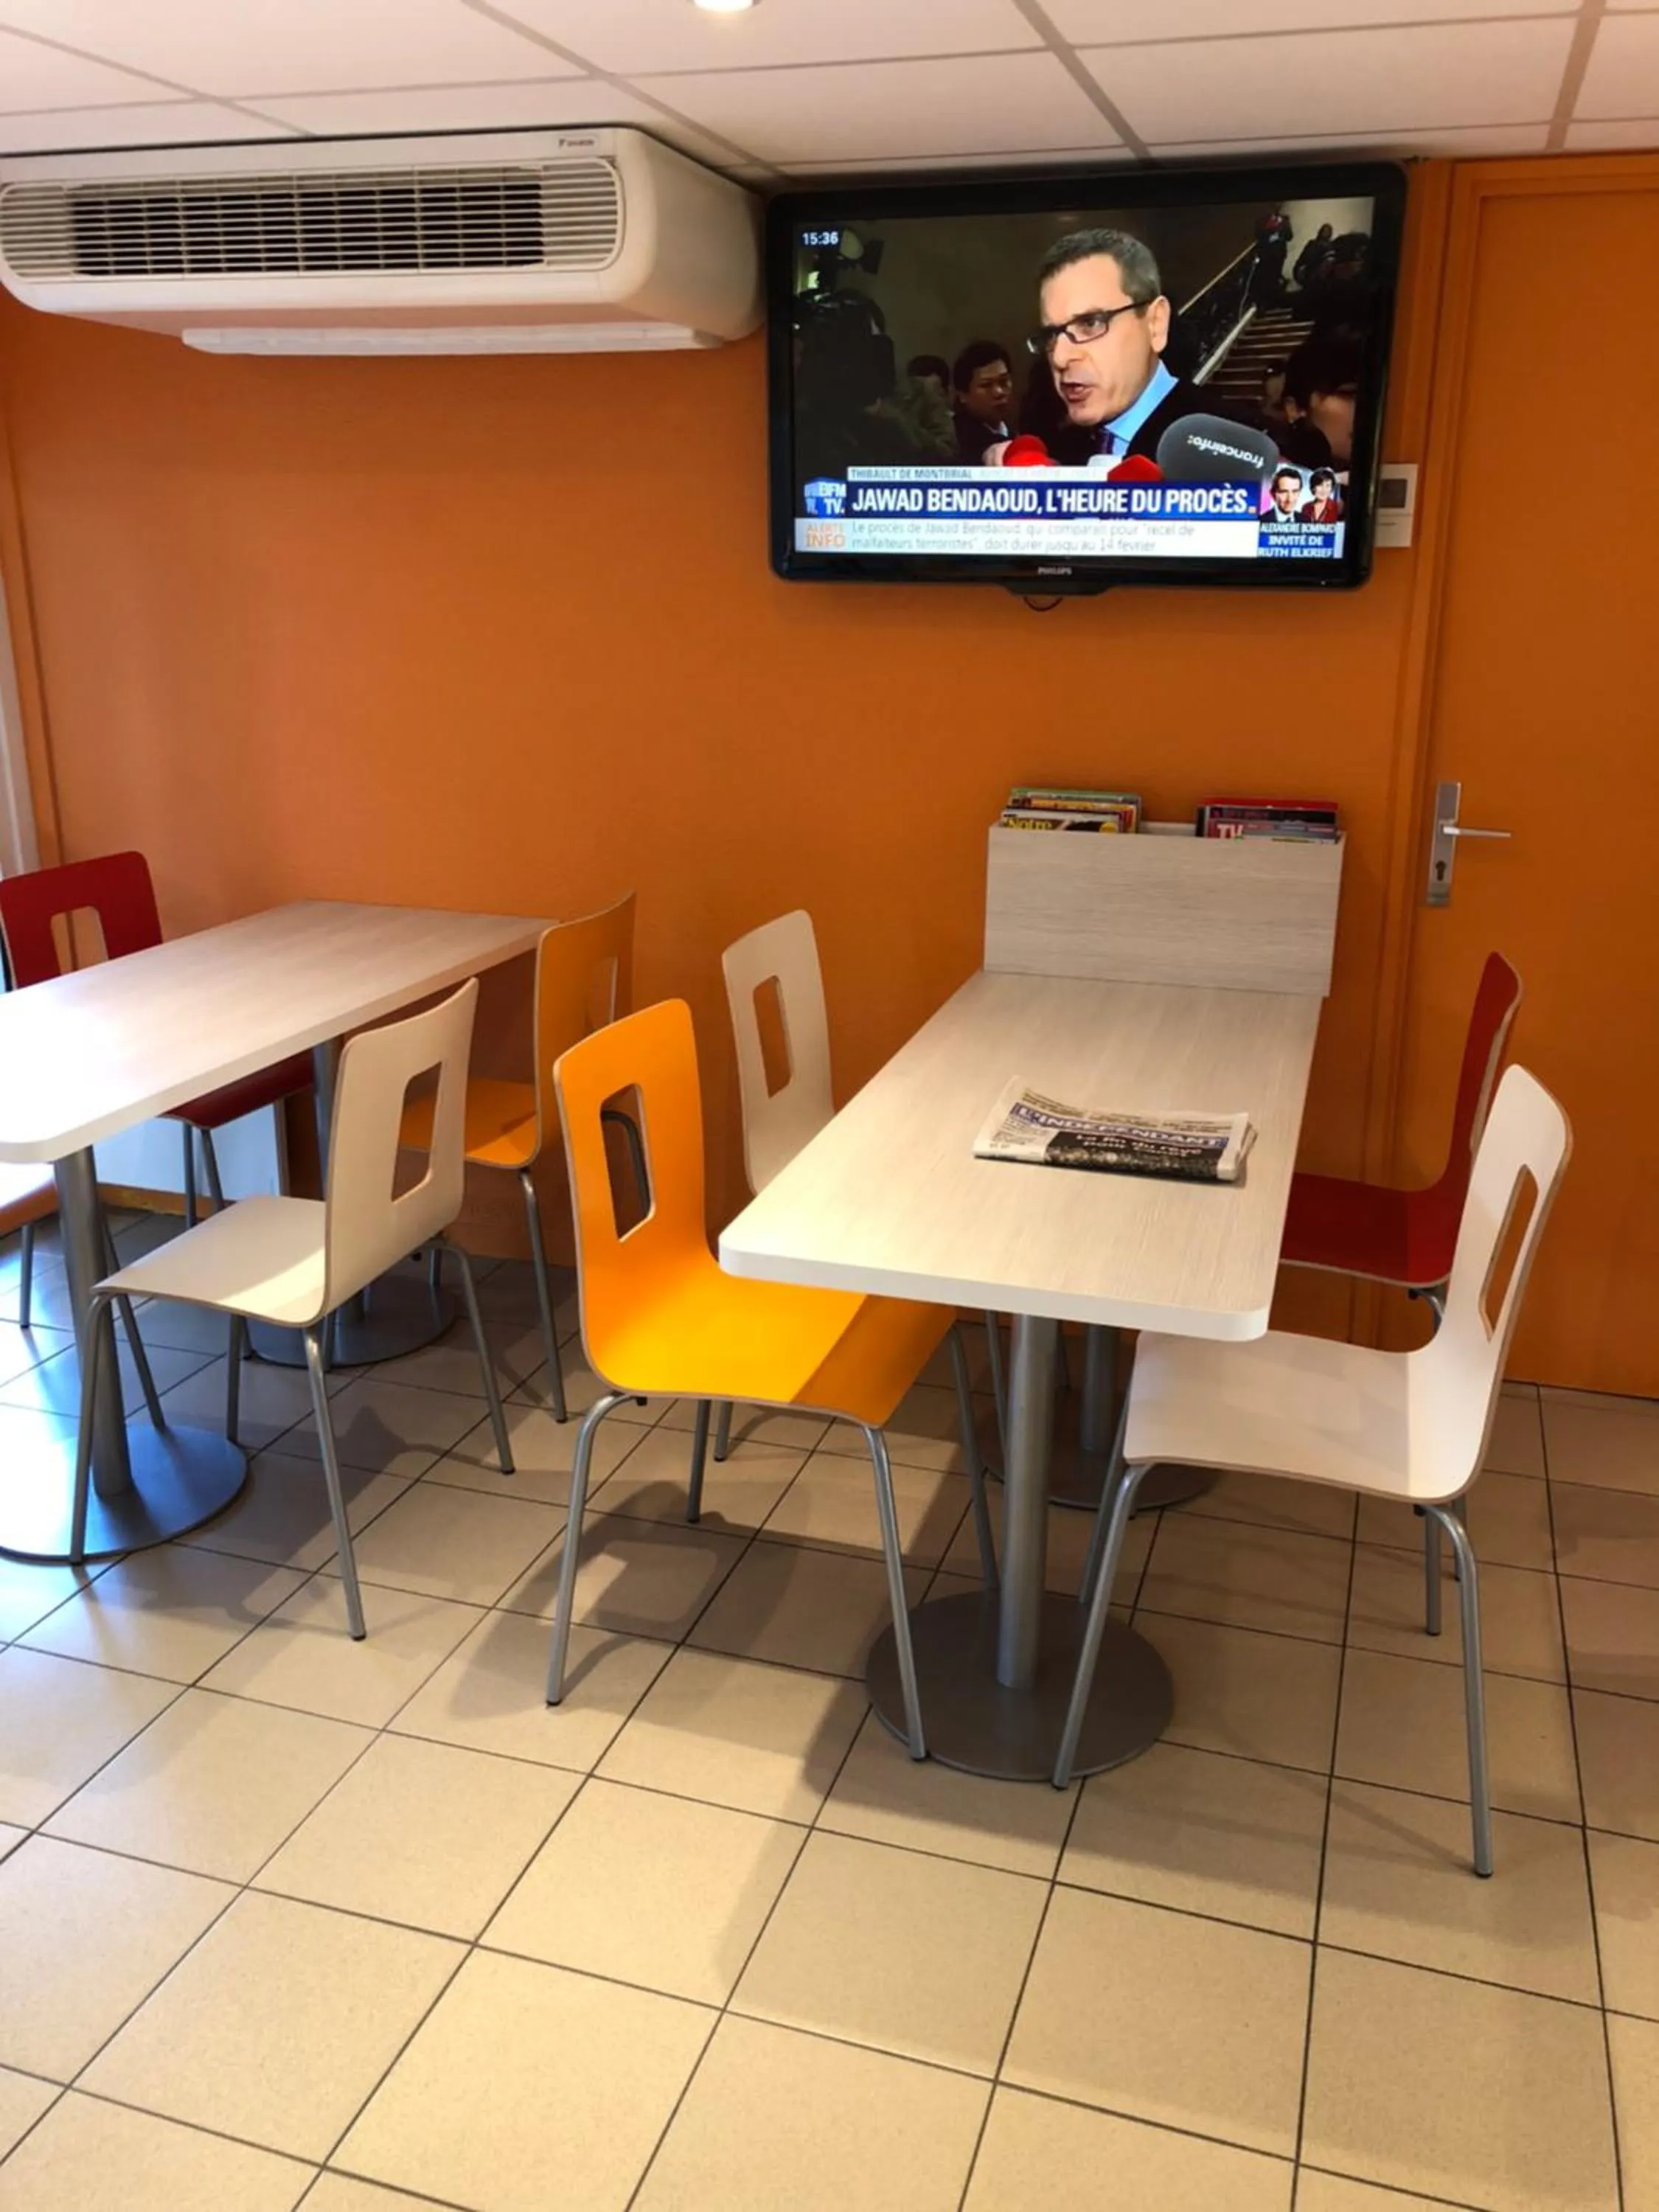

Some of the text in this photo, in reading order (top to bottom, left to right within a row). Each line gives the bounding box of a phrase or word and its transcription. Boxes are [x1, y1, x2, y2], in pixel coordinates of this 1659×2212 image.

[802, 231, 838, 246] 15:36
[852, 469, 897, 479] THIBAULT
[900, 469, 914, 479] DE
[819, 481, 846, 497] BFM
[852, 488, 922, 512] JAWAD
[927, 488, 1043, 515] BENDAOUD,
[1046, 488, 1129, 513] L'HEURE
[1130, 488, 1162, 513] DU
[852, 521, 866, 534] Le
[907, 522, 922, 534] de
[805, 534, 846, 548] INFO
[1308, 535, 1324, 546] DE
[1037, 566, 1072, 576] PHILIPS
